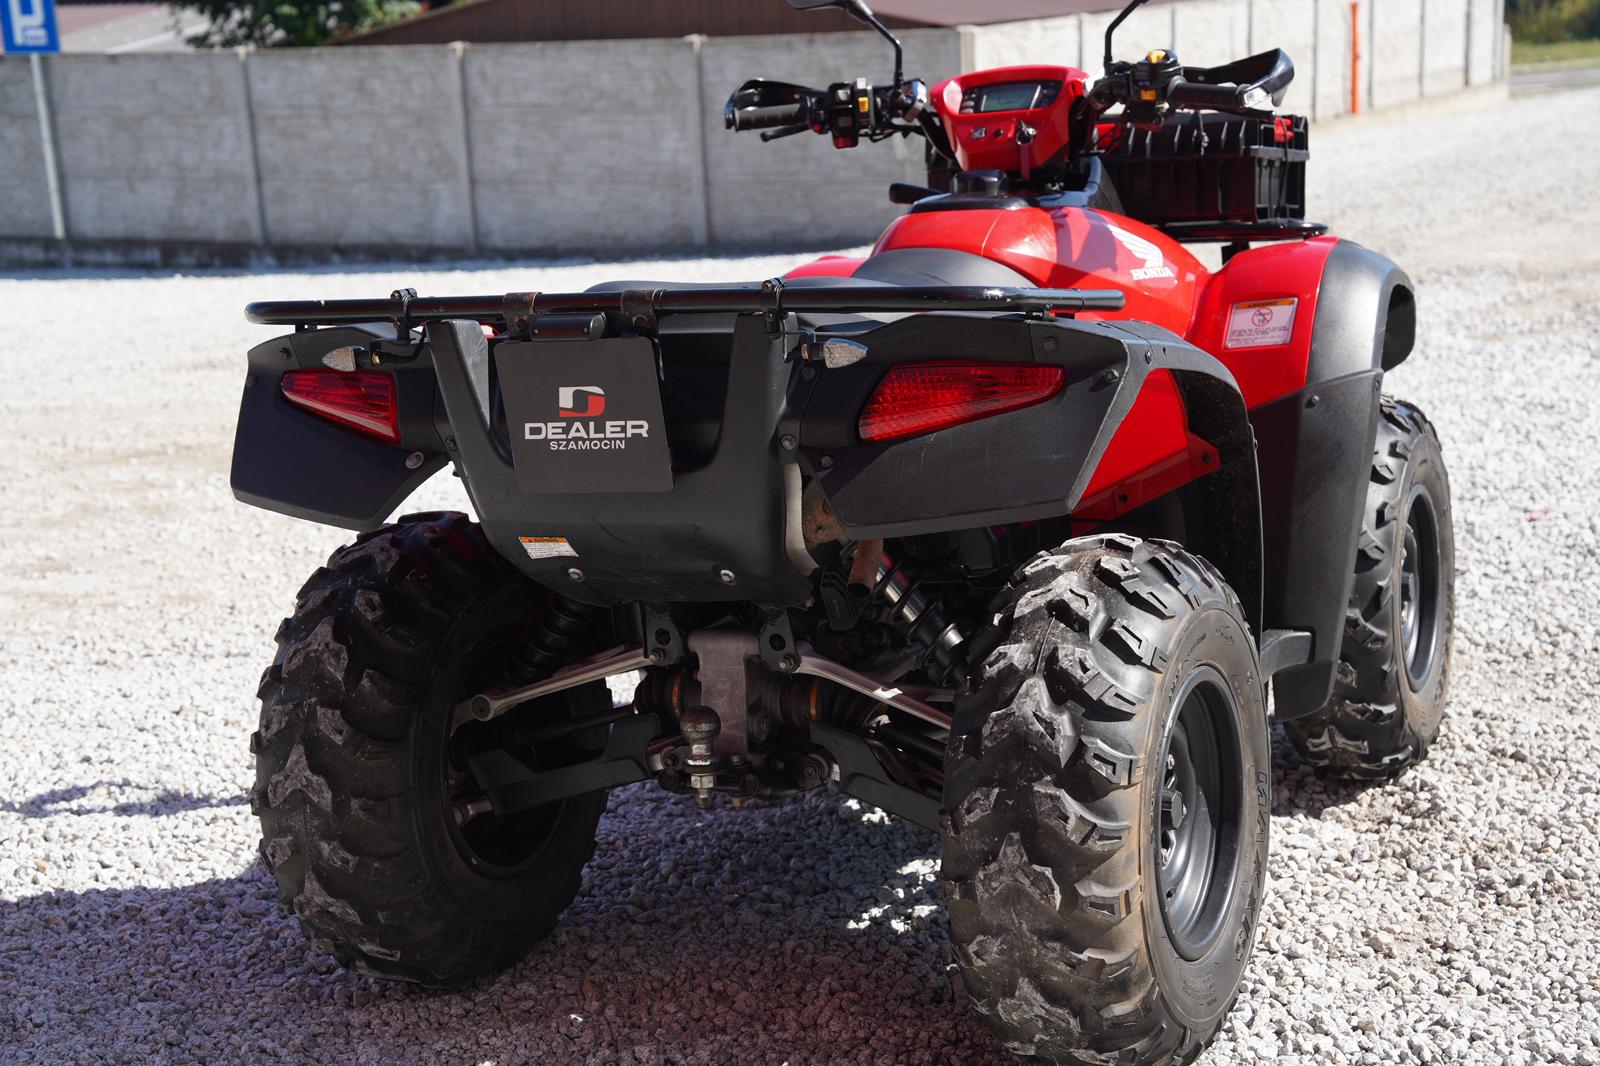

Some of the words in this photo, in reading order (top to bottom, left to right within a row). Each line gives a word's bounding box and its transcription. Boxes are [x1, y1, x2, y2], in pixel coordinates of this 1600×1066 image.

[1130, 266, 1175, 280] HONDA
[524, 420, 649, 440] DEALER
[550, 440, 625, 451] SZAMOCIN
